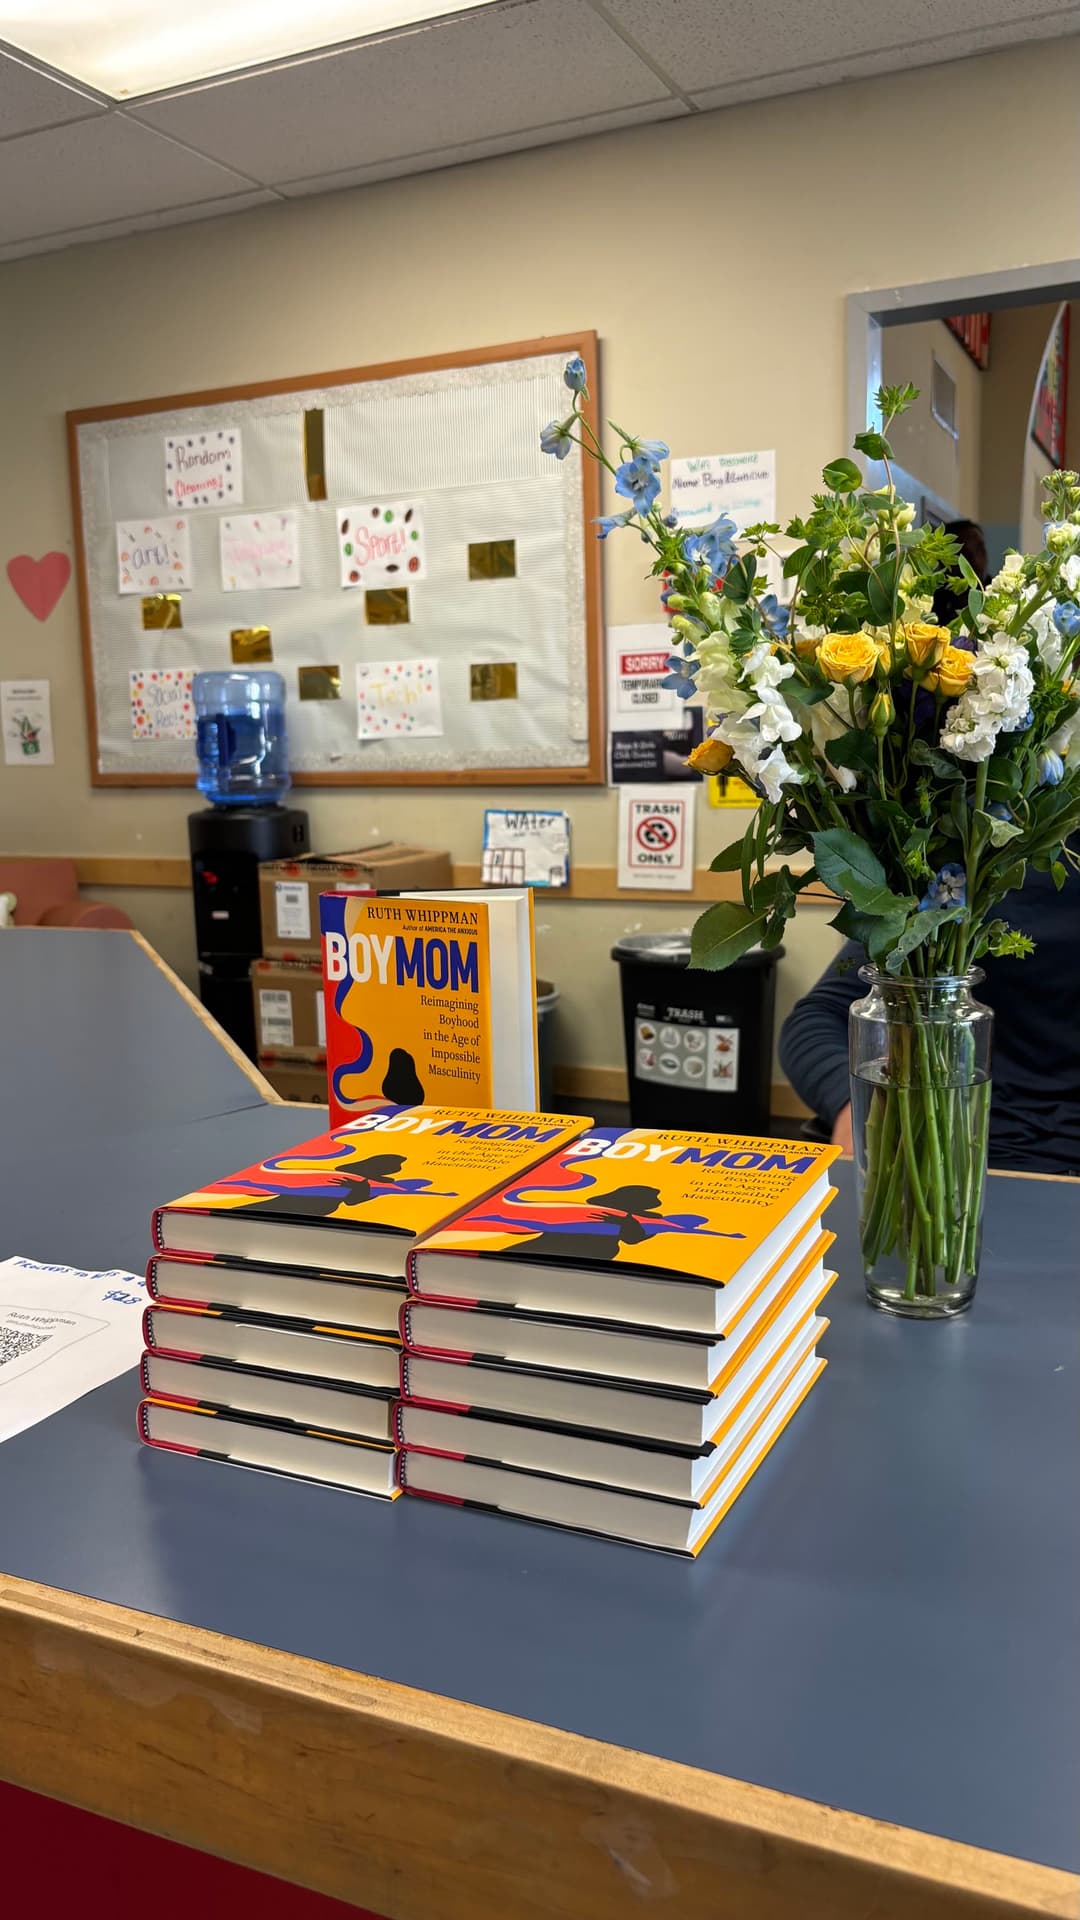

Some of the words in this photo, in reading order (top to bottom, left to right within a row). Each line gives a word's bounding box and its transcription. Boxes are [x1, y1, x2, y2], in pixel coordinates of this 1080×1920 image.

[175, 446, 232, 472] Random
[625, 655, 667, 671] SORRY
[635, 804, 681, 814] TRASH
[637, 853, 674, 864] ONLY
[367, 906, 402, 921] RUTH
[405, 908, 478, 925] WHIPPMAN
[325, 931, 479, 994] BOYMOM
[420, 995, 479, 1015] Reimagining
[439, 1014, 479, 1029] Boyhood
[423, 1029, 433, 1040] in
[434, 1030, 449, 1042] the
[451, 1032, 469, 1047] Age
[471, 1034, 480, 1046] of
[431, 1047, 480, 1064] Impossible
[428, 1064, 480, 1084] Masculinity
[433, 1109, 482, 1118] RUTH
[485, 1113, 579, 1125] WHIPPMAN
[340, 1113, 566, 1143] BOYMOM
[455, 1138, 536, 1149] Reimagining
[470, 1145, 529, 1154] Boyhood
[657, 1133, 710, 1143] RUTH
[717, 1138, 827, 1153] WHIPPMAN
[436, 1155, 510, 1165] Impossible
[564, 1138, 818, 1175] BOYMOM
[422, 1161, 501, 1171] Masculinity
[701, 1168, 799, 1181] Reimagining
[724, 1176, 793, 1187] Boyhood
[693, 1187, 780, 1200] Impossible
[735, 1184, 766, 1192] Age
[682, 1193, 774, 1208] Masculinity
[101, 1289, 143, 1304] $28
